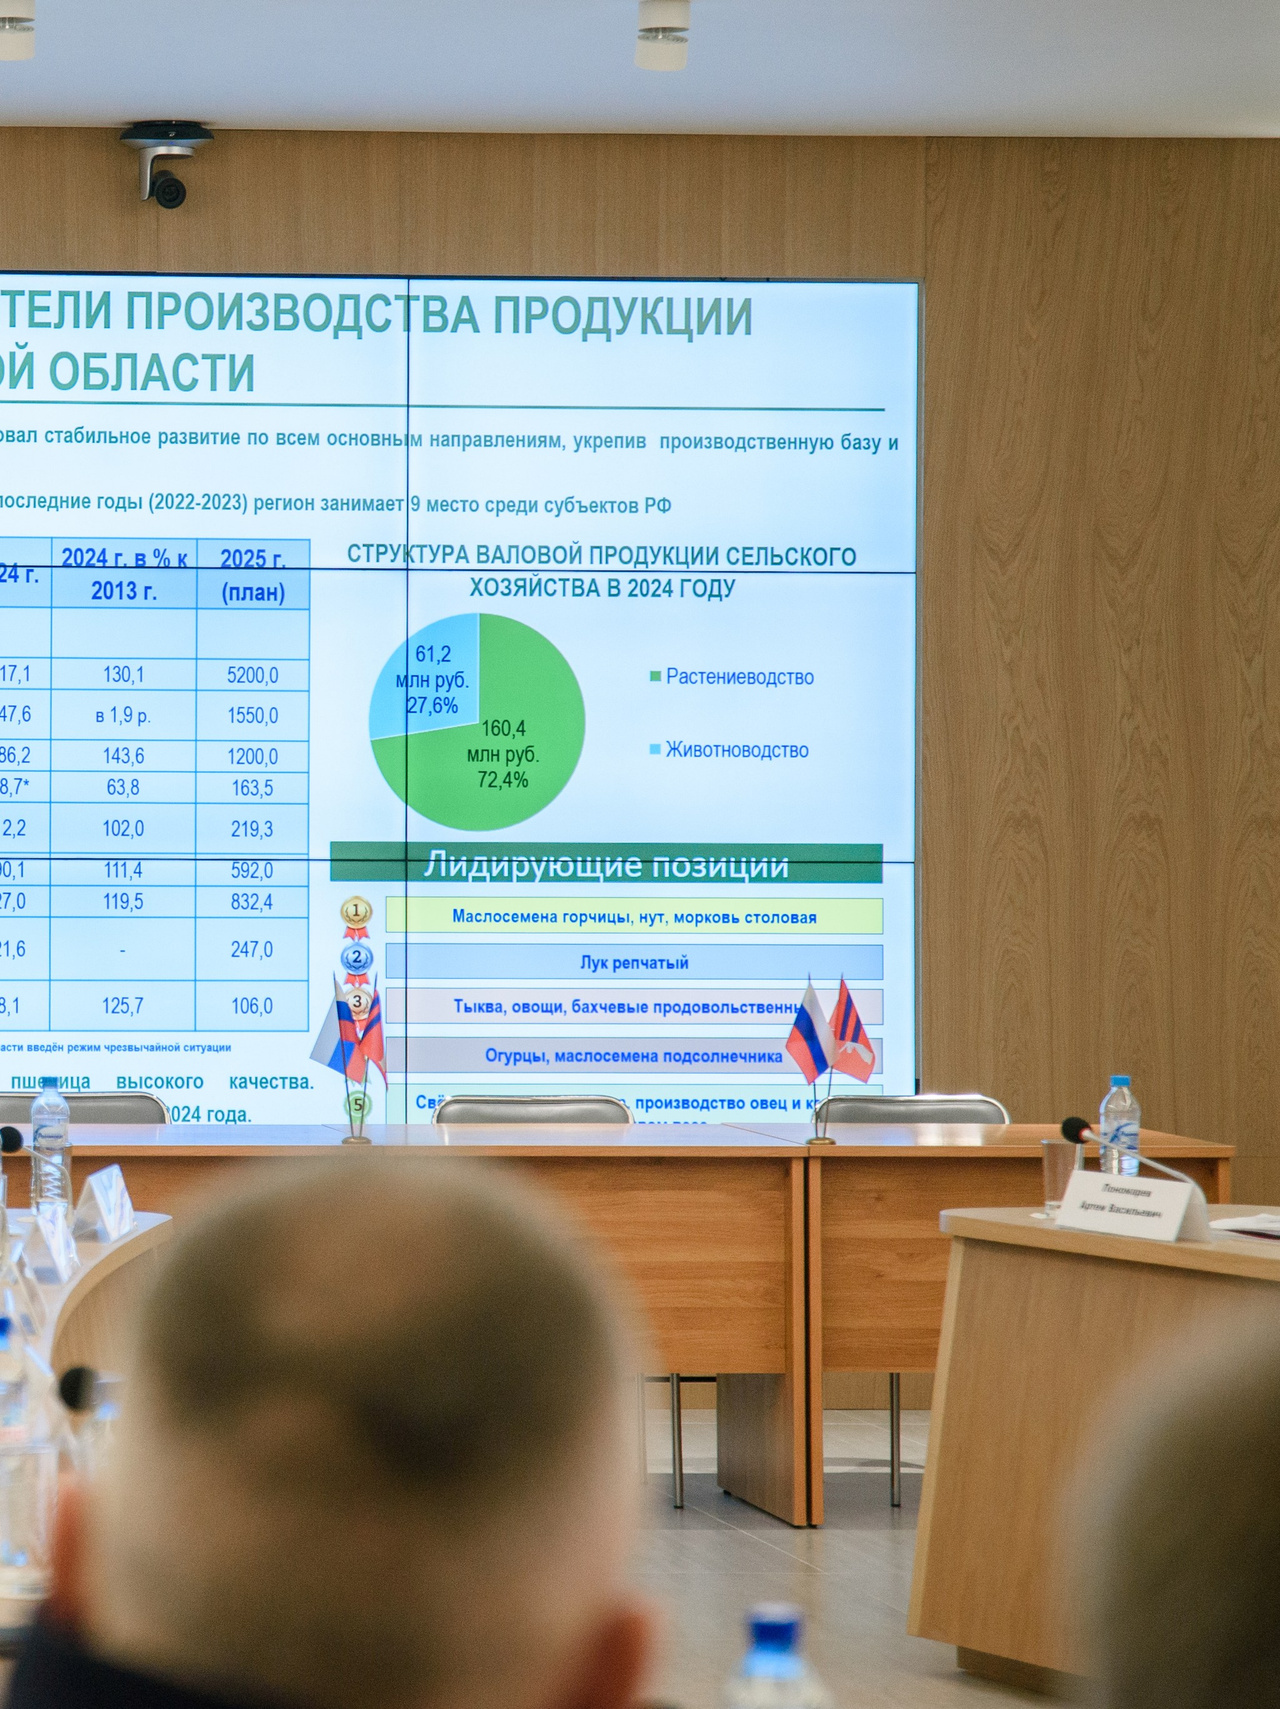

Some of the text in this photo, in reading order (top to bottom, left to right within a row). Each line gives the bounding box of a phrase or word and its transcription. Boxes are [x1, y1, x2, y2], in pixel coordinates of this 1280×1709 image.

[126, 291, 481, 339] ПРОИЗВОДСТВА
[494, 295, 752, 342] ПРОДУКЦИИ
[49, 350, 255, 394] ОБЛАСТИ
[44, 425, 152, 443] стабильное
[158, 431, 241, 449] развитие
[247, 432, 269, 445] по
[275, 432, 320, 445] всем
[326, 432, 423, 451] основным
[429, 434, 566, 452] направлениям,
[573, 435, 647, 453] укрепив
[660, 436, 834, 454] производственную
[840, 432, 882, 455] базу
[888, 436, 899, 450] и
[97, 495, 143, 512] годы
[148, 492, 248, 515] (2022-2023)
[253, 496, 315, 515] регион
[320, 497, 405, 511] занимает
[410, 495, 421, 512] 9
[426, 499, 480, 512] место
[484, 499, 539, 518] среди
[543, 495, 639, 517] субъектов
[644, 496, 672, 514] РФ
[61, 547, 188, 567] 2024 г. в % к
[347, 540, 857, 569] СТРУКТУРА ВАЛОВОЙ ПРОДУКЦИИ СЕЛЬСКОГО
[90, 580, 158, 600] 2013 г.
[221, 581, 286, 606] (план)
[469, 575, 736, 602] ХОЗЯЙСТВА В 2024 ГОДУ
[415, 645, 451, 665] 61,2
[227, 665, 279, 686] 5200,0
[395, 671, 470, 694] млн руб.
[666, 666, 815, 688] Растениеводство
[482, 719, 526, 739] 160,4
[665, 740, 810, 760] Животноводство
[232, 778, 274, 799] 163,5
[477, 770, 529, 791] 72,4%
[424, 849, 790, 883] Лидирующие позиции
[352, 903, 361, 917] 1
[452, 908, 817, 926] Маслосемена горчицы, нут, морковь столовая
[352, 949, 362, 964] 2
[579, 953, 689, 973] Лук репчатый
[453, 998, 507, 1016] Тыква,
[511, 1002, 567, 1016] овощи,
[571, 998, 649, 1013] бахчевые
[26, 1042, 65, 1053] введён
[66, 1044, 102, 1054] режим
[103, 1042, 181, 1054] чрезвычайной
[183, 1044, 232, 1054] ситуации
[484, 1047, 784, 1067] Огурцы, маслосемена подсолнечника
[11, 1075, 91, 1092] пшеица
[116, 1076, 204, 1090] высокого
[229, 1076, 315, 1090] качества.
